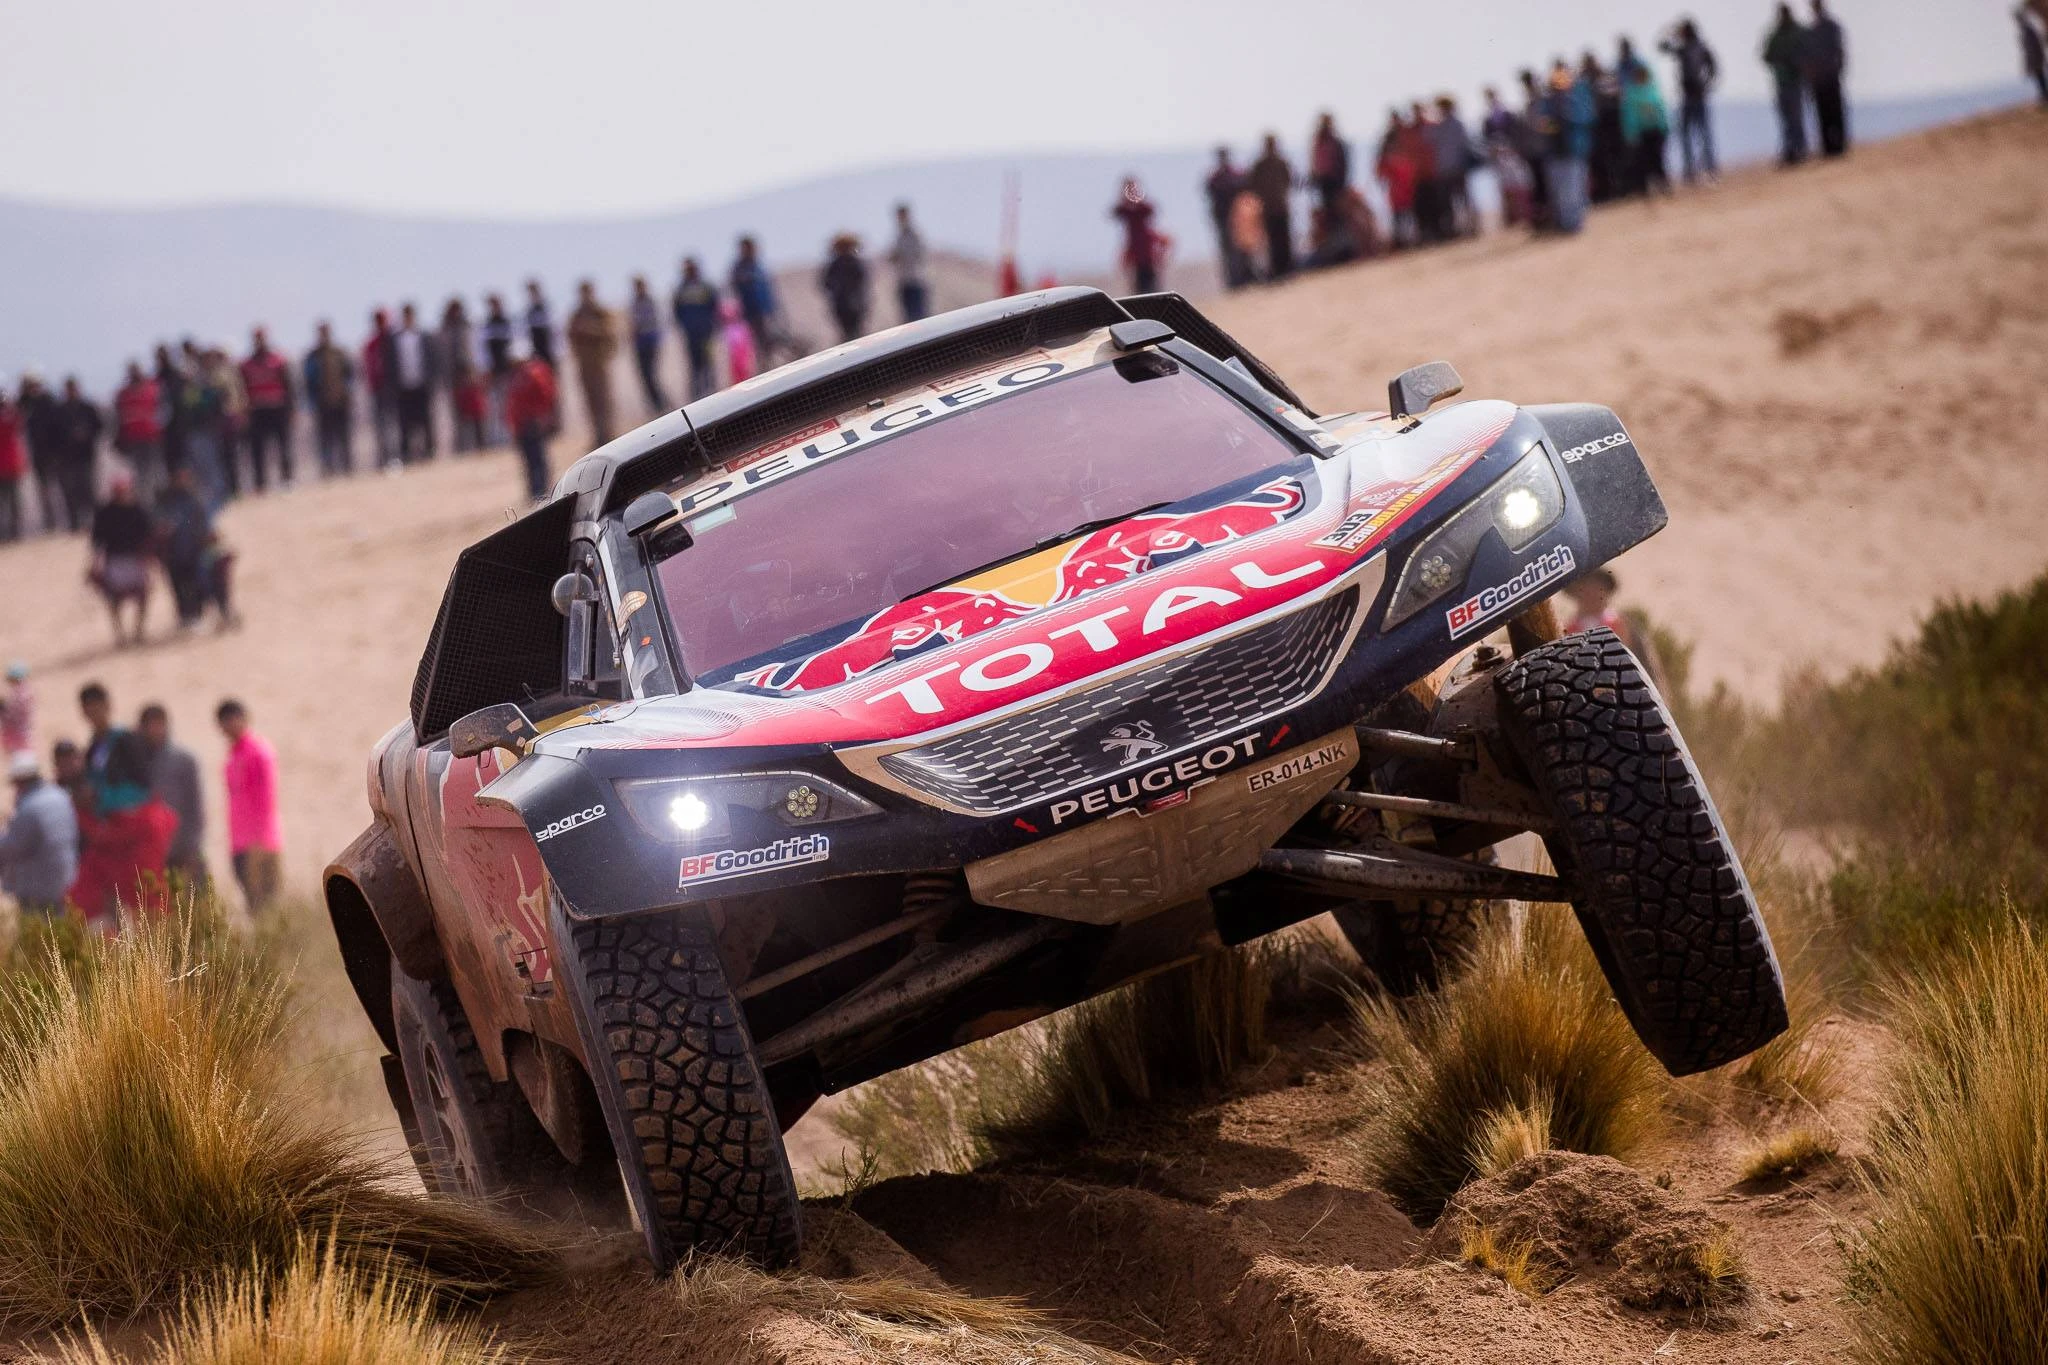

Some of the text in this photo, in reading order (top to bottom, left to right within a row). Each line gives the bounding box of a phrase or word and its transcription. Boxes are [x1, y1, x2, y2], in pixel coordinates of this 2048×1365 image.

[736, 425, 829, 467] MOTUL
[1562, 432, 1629, 462] sparco
[1323, 513, 1372, 542] 303
[1371, 492, 1417, 527] BOLIVIA
[1449, 546, 1573, 629] BFGoodrich
[865, 559, 1325, 715] TOTAL
[1050, 732, 1262, 825] PEUGEOT
[1248, 743, 1347, 792] ER-014-NK
[681, 836, 828, 878] BFGoodrich
